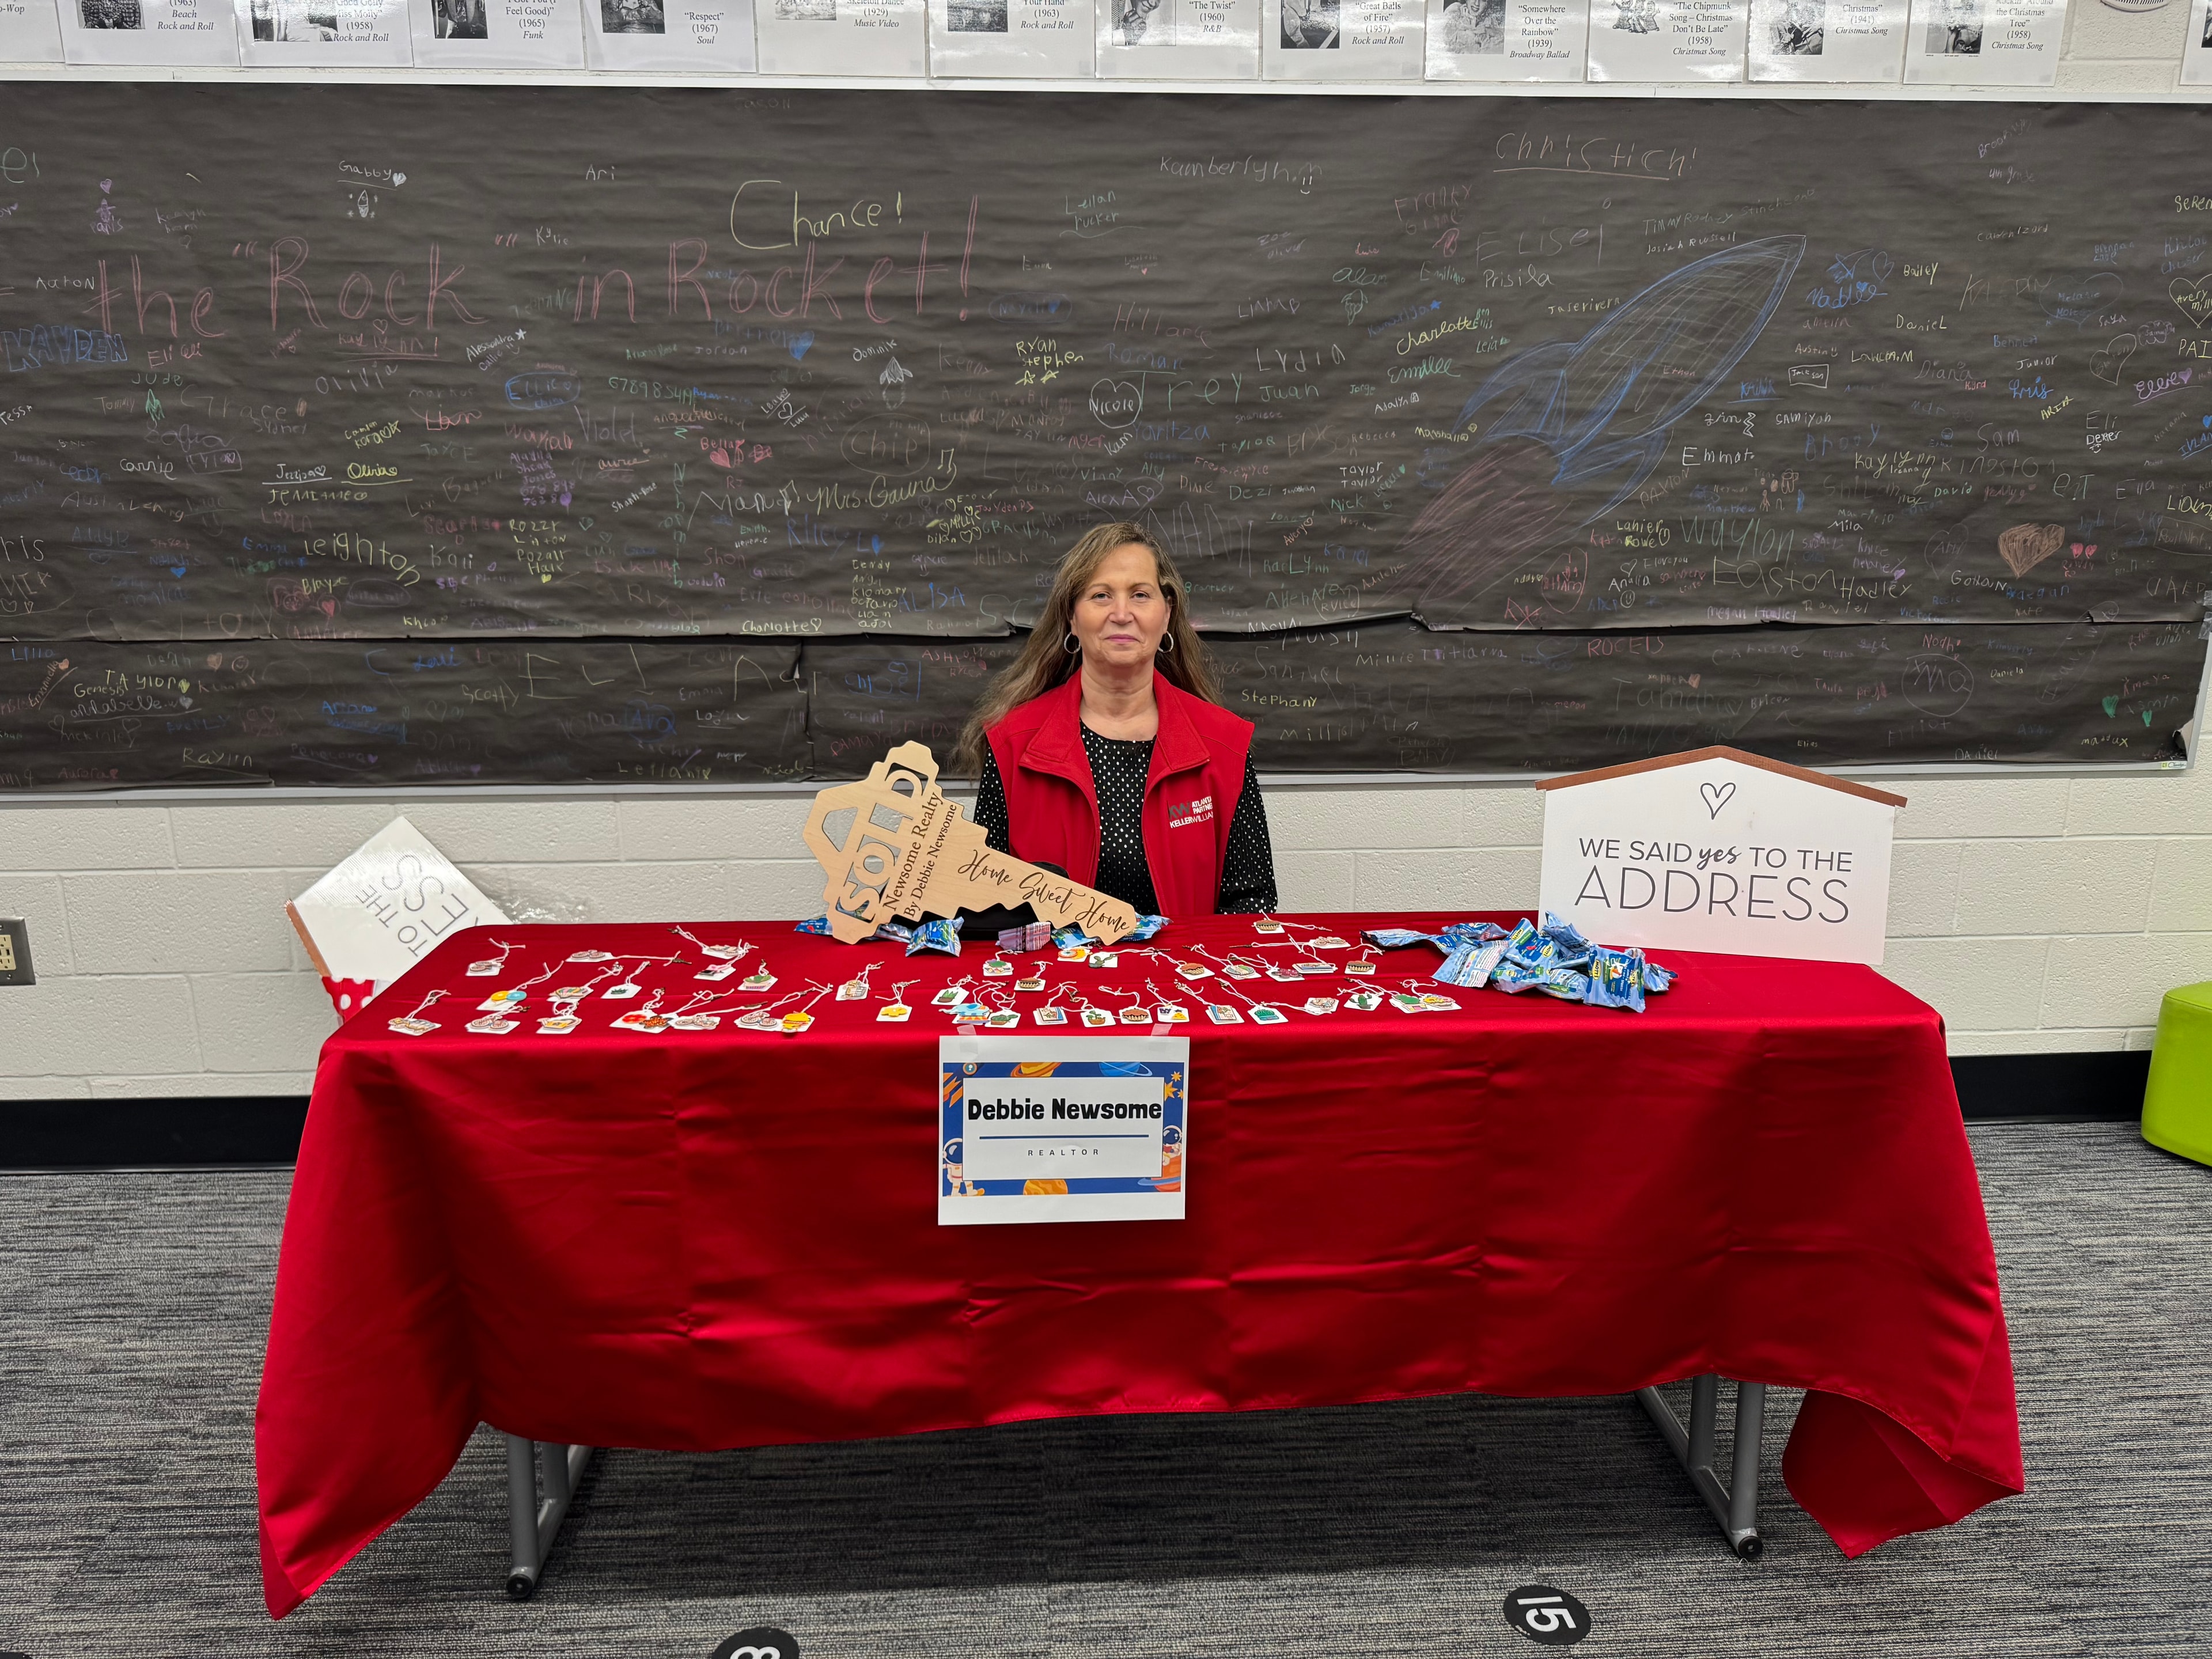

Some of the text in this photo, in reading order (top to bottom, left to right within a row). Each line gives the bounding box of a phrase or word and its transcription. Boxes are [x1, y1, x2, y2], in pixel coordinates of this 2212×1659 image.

[506, 6, 523, 15] Feel
[1382, 2, 1402, 10] Balls
[1694, 1, 1732, 12] Chipmunk
[172, 9, 197, 18] Beach
[863, 8, 888, 17] (1929)
[1034, 9, 1059, 19] (1963)
[2009, 7, 2045, 16] Christmas
[1200, 13, 1225, 22] (1960)
[1669, 13, 1687, 23] Song
[1696, 13, 1733, 21] Christmas
[1850, 16, 1874, 25] (1941)
[157, 21, 214, 31] Rock and Roll
[346, 21, 373, 31] (1958)
[519, 19, 546, 29] (1965)
[854, 19, 899, 28] Music Video
[1021, 21, 1074, 29] Rock and Roll
[692, 24, 718, 34] (1967)
[1366, 25, 1391, 34] (1957)
[1696, 25, 1706, 33] Be
[1871, 27, 1888, 36] Song
[334, 33, 389, 42] Rock and Roll
[523, 31, 544, 39] Funk
[697, 36, 715, 44] Soul
[1352, 36, 1404, 44] Rock and Roll
[2007, 31, 2031, 40] (1958)
[1528, 40, 1552, 48] (1939)
[1688, 36, 1712, 46] (1958)
[2027, 41, 2044, 51] Song
[1510, 51, 1544, 60] Broadway
[1673, 47, 1726, 56] Christmas Song
[339, 160, 393, 181] Gabby
[585, 164, 615, 181] Ari
[730, 180, 902, 249] Chance!
[83, 254, 225, 339] the
[575, 255, 637, 323] in
[668, 195, 978, 324] Rocket!
[1259, 384, 1319, 402] Juan
[2086, 410, 2119, 430] Eli
[1977, 422, 2020, 453] Sam
[1330, 495, 1364, 511] Nick
[1827, 520, 1864, 532] Mila
[1840, 575, 1913, 600] Hadley
[742, 620, 812, 634] Charlotte
[882, 791, 945, 912] Newsome Realty
[1578, 838, 1853, 872] WE SAID yes TO THE
[903, 804, 957, 919] By Debbie Newsome
[957, 849, 1130, 933] Home Sweet Home
[1574, 865, 1850, 924] ADDRESS
[967, 1097, 1162, 1120] Debbie Newsome
[1028, 1148, 1099, 1157] REALTOR
[1517, 1596, 1577, 1632] 15
